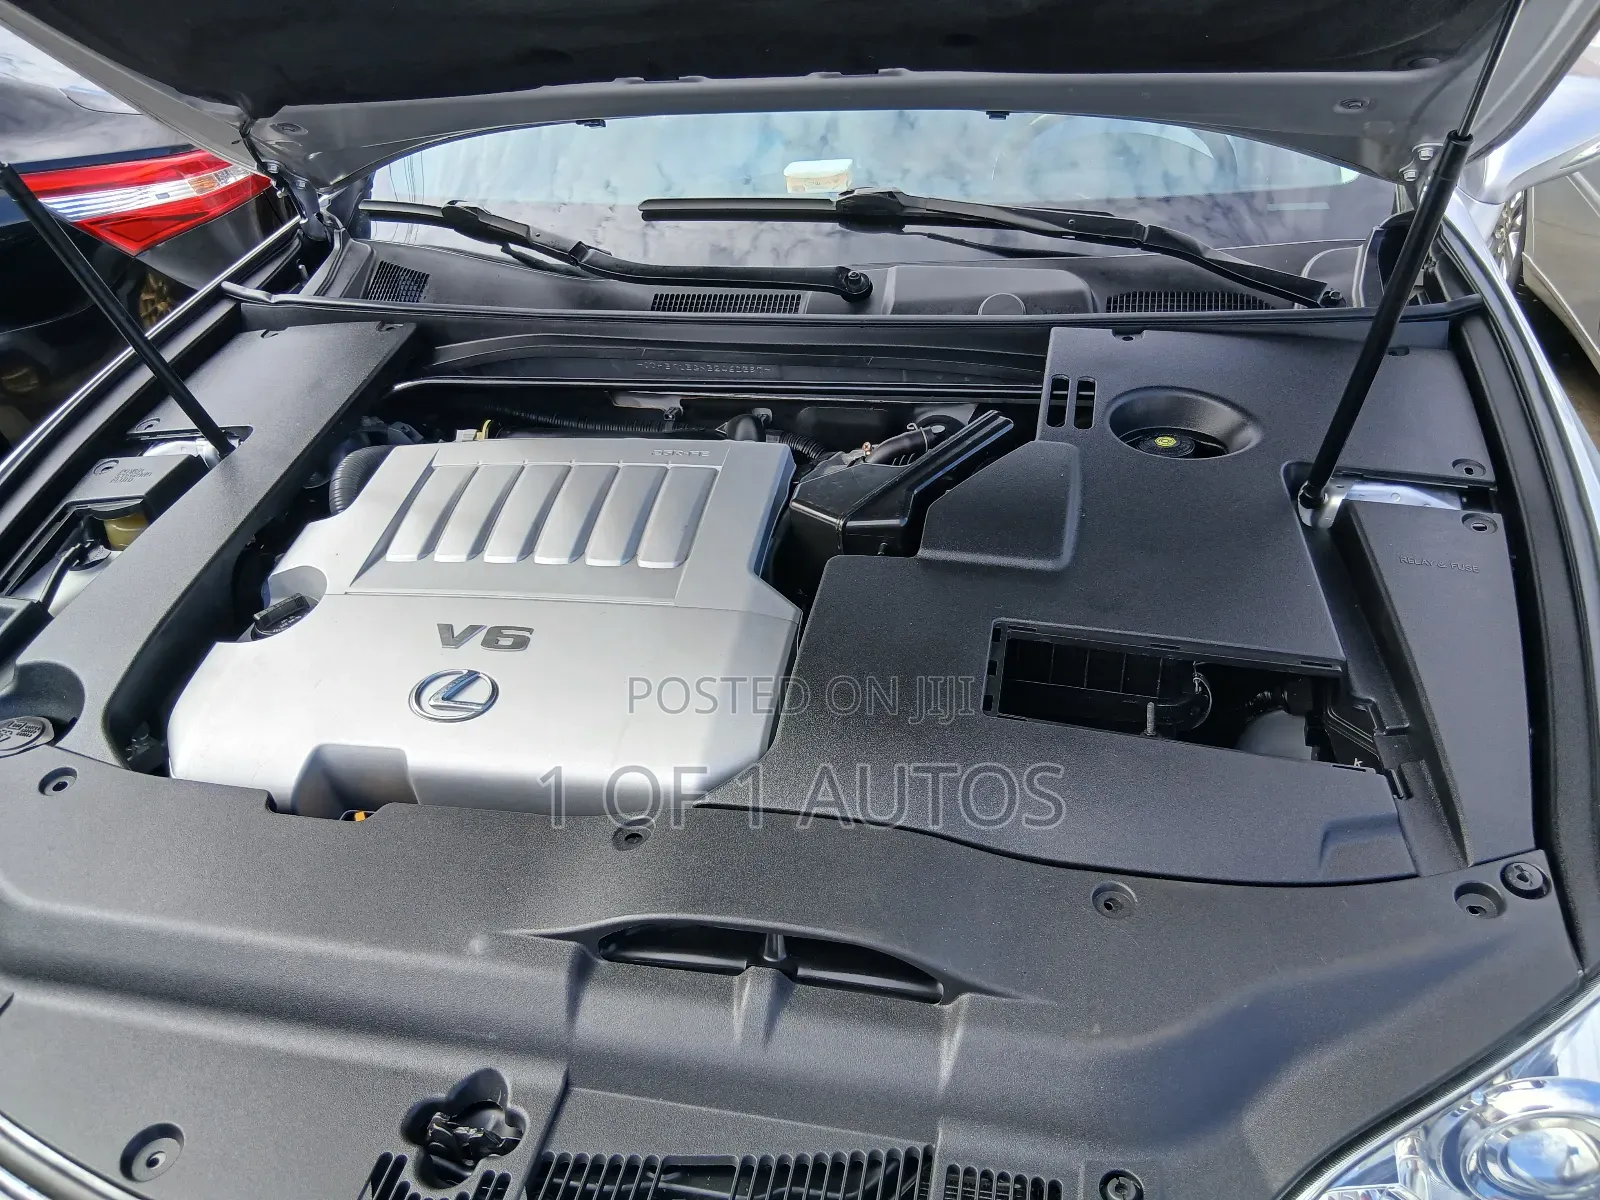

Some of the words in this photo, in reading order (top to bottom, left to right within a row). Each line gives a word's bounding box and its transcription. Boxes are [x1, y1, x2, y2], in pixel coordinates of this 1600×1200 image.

[1399, 556, 1434, 567] RELAY
[1437, 560, 1447, 569] &
[1450, 562, 1480, 573] FUSE
[436, 622, 535, 653] V6
